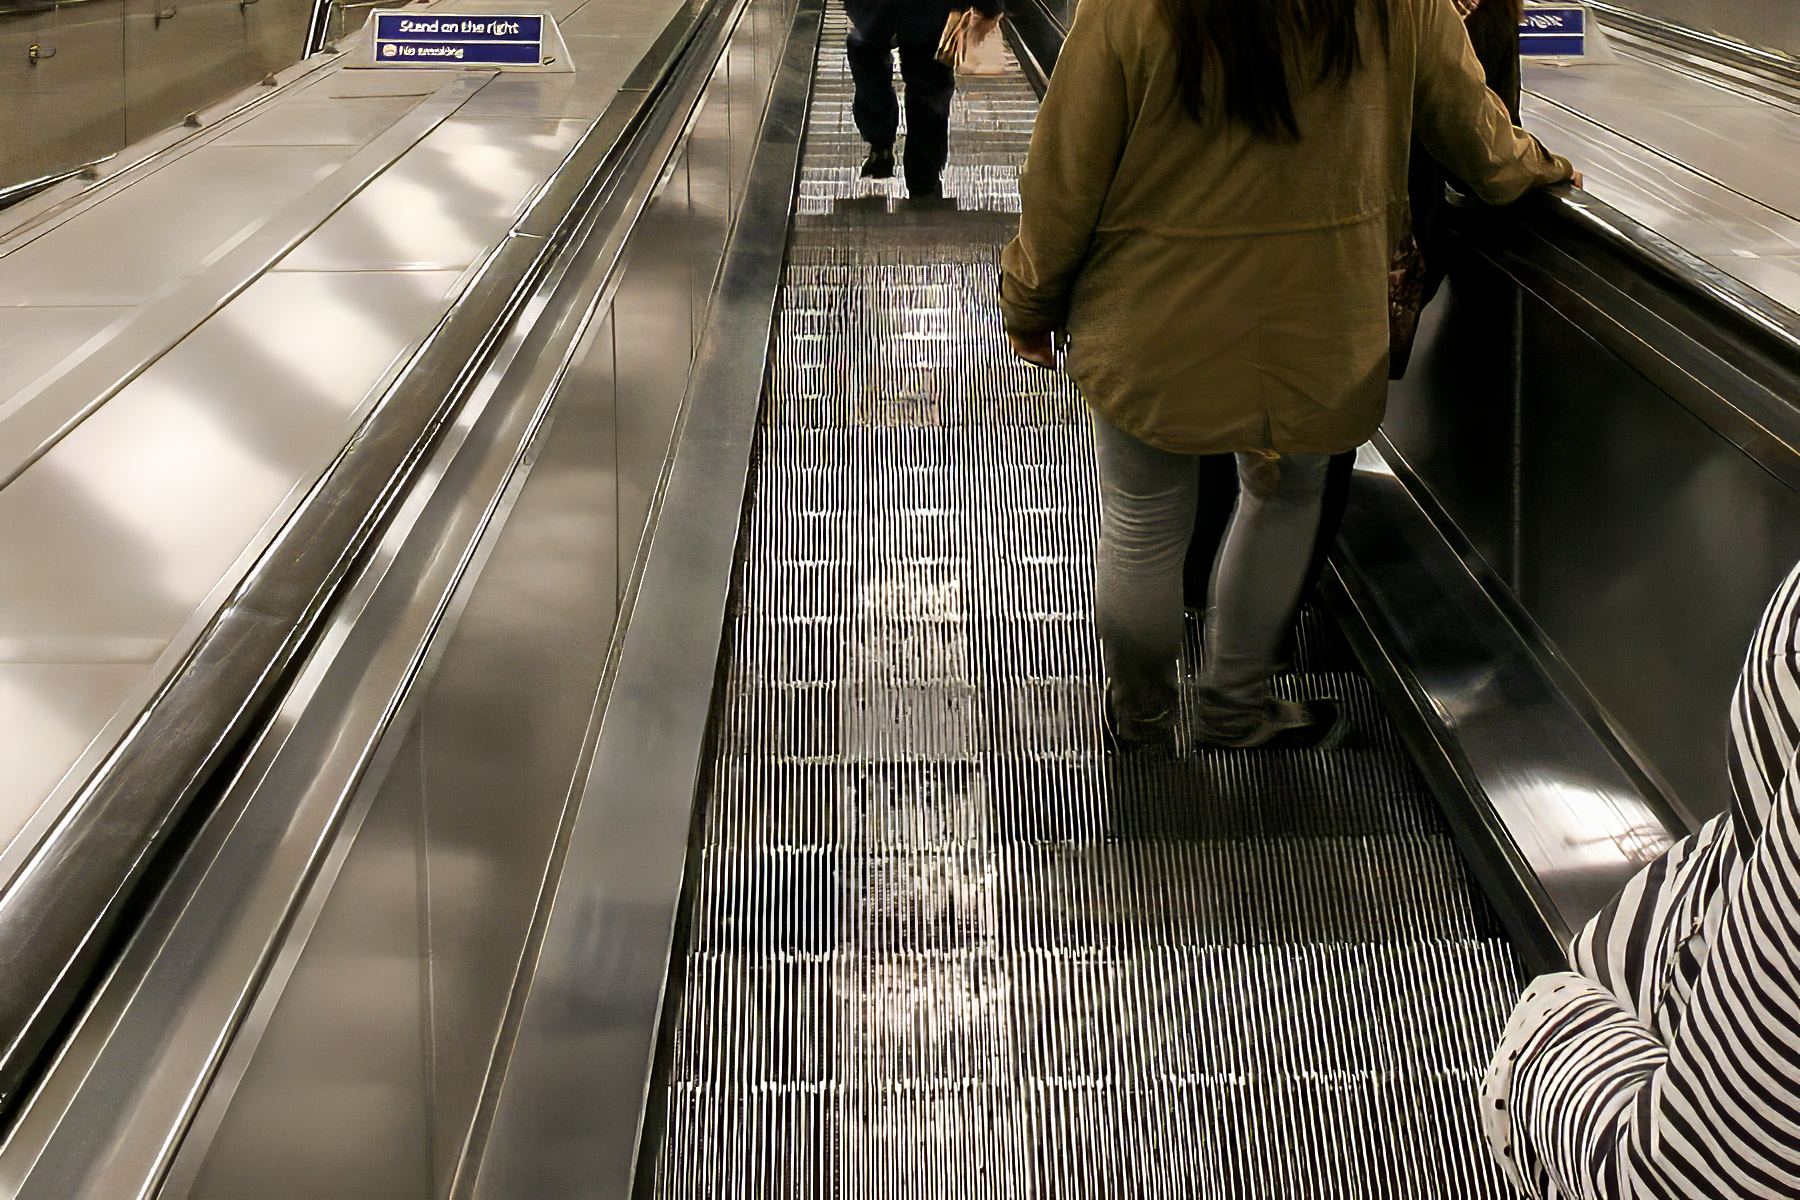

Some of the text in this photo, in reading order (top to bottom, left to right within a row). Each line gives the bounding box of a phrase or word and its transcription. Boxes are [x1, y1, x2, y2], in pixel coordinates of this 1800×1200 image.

[399, 20, 520, 36] Stand on the right
